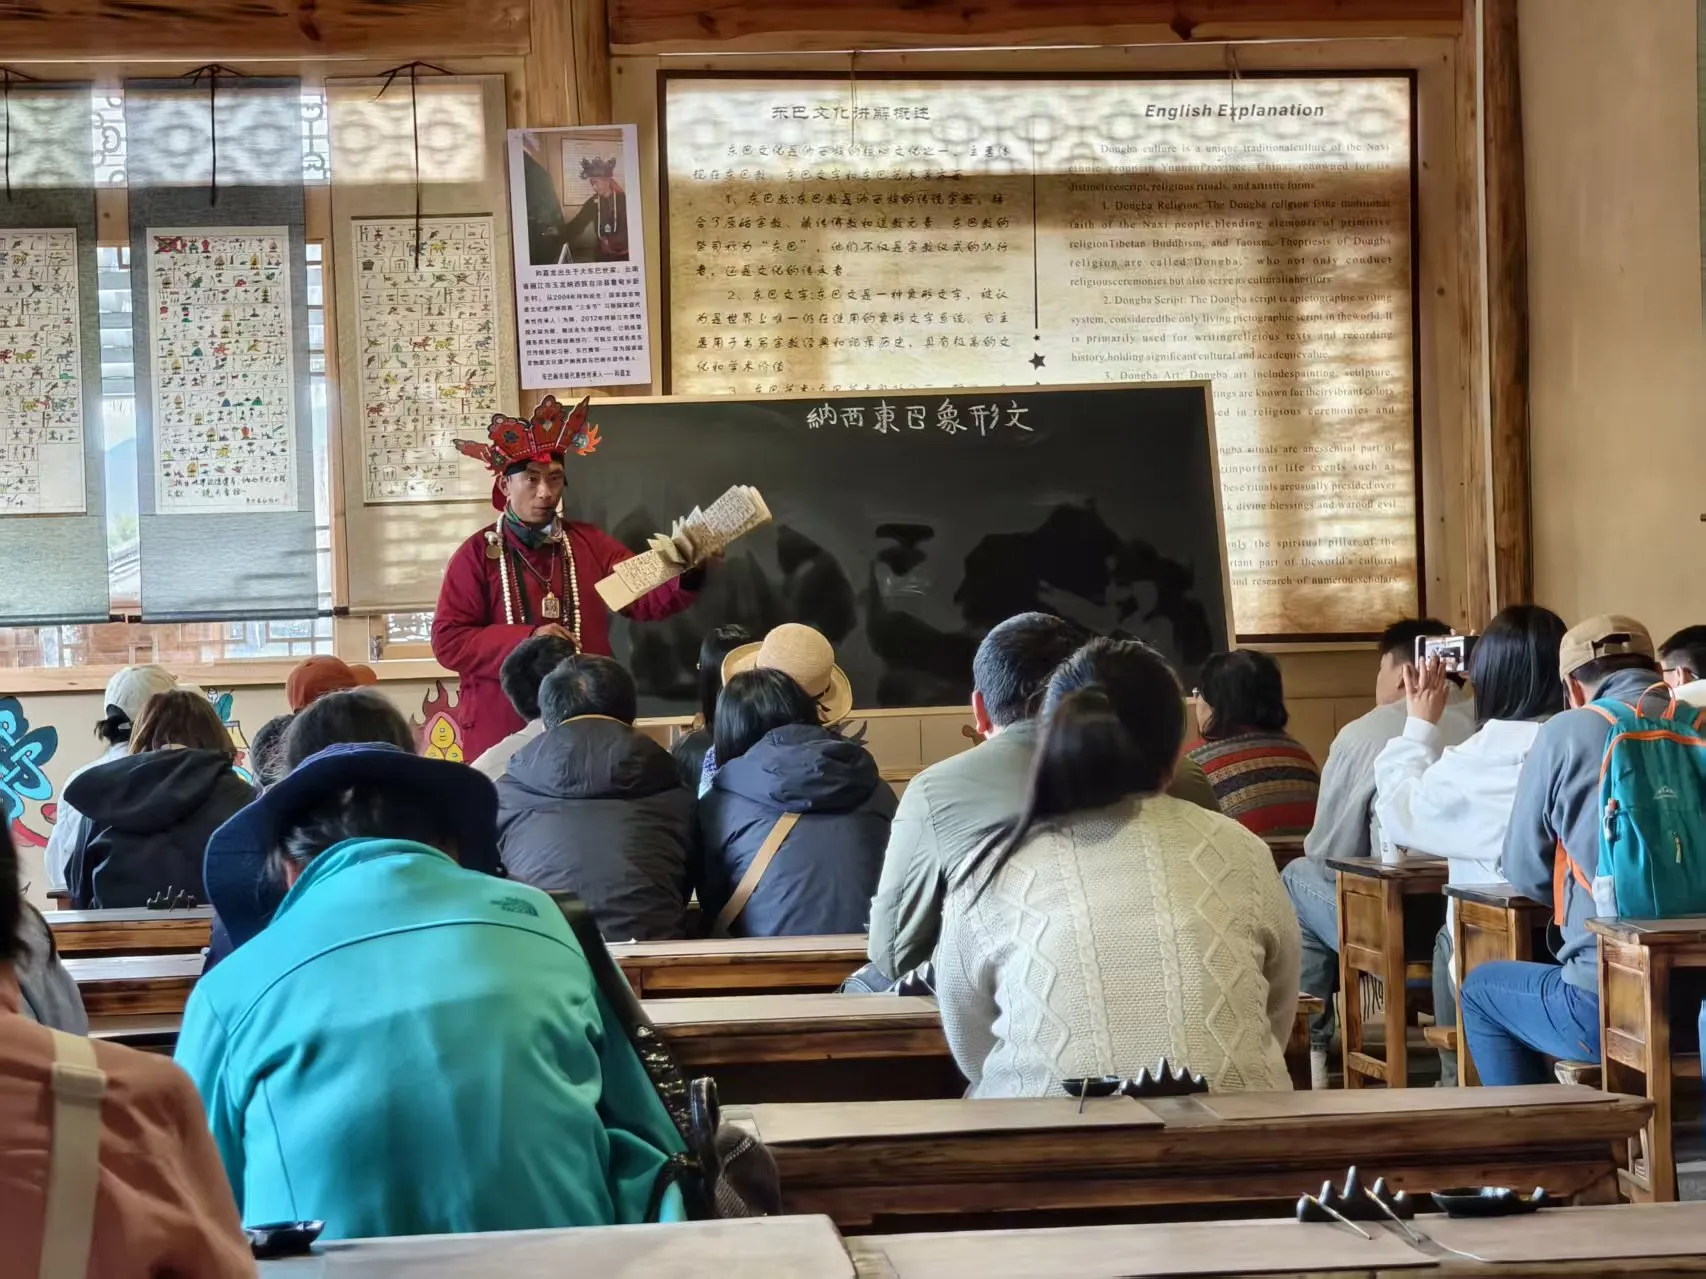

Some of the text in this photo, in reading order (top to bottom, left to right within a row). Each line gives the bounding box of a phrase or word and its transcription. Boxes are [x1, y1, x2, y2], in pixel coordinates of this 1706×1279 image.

[771, 105, 930, 120] 东巴文化讲解概述
[1145, 103, 1325, 120] English Explanation
[806, 398, 1034, 436] 納西東巴象形文
